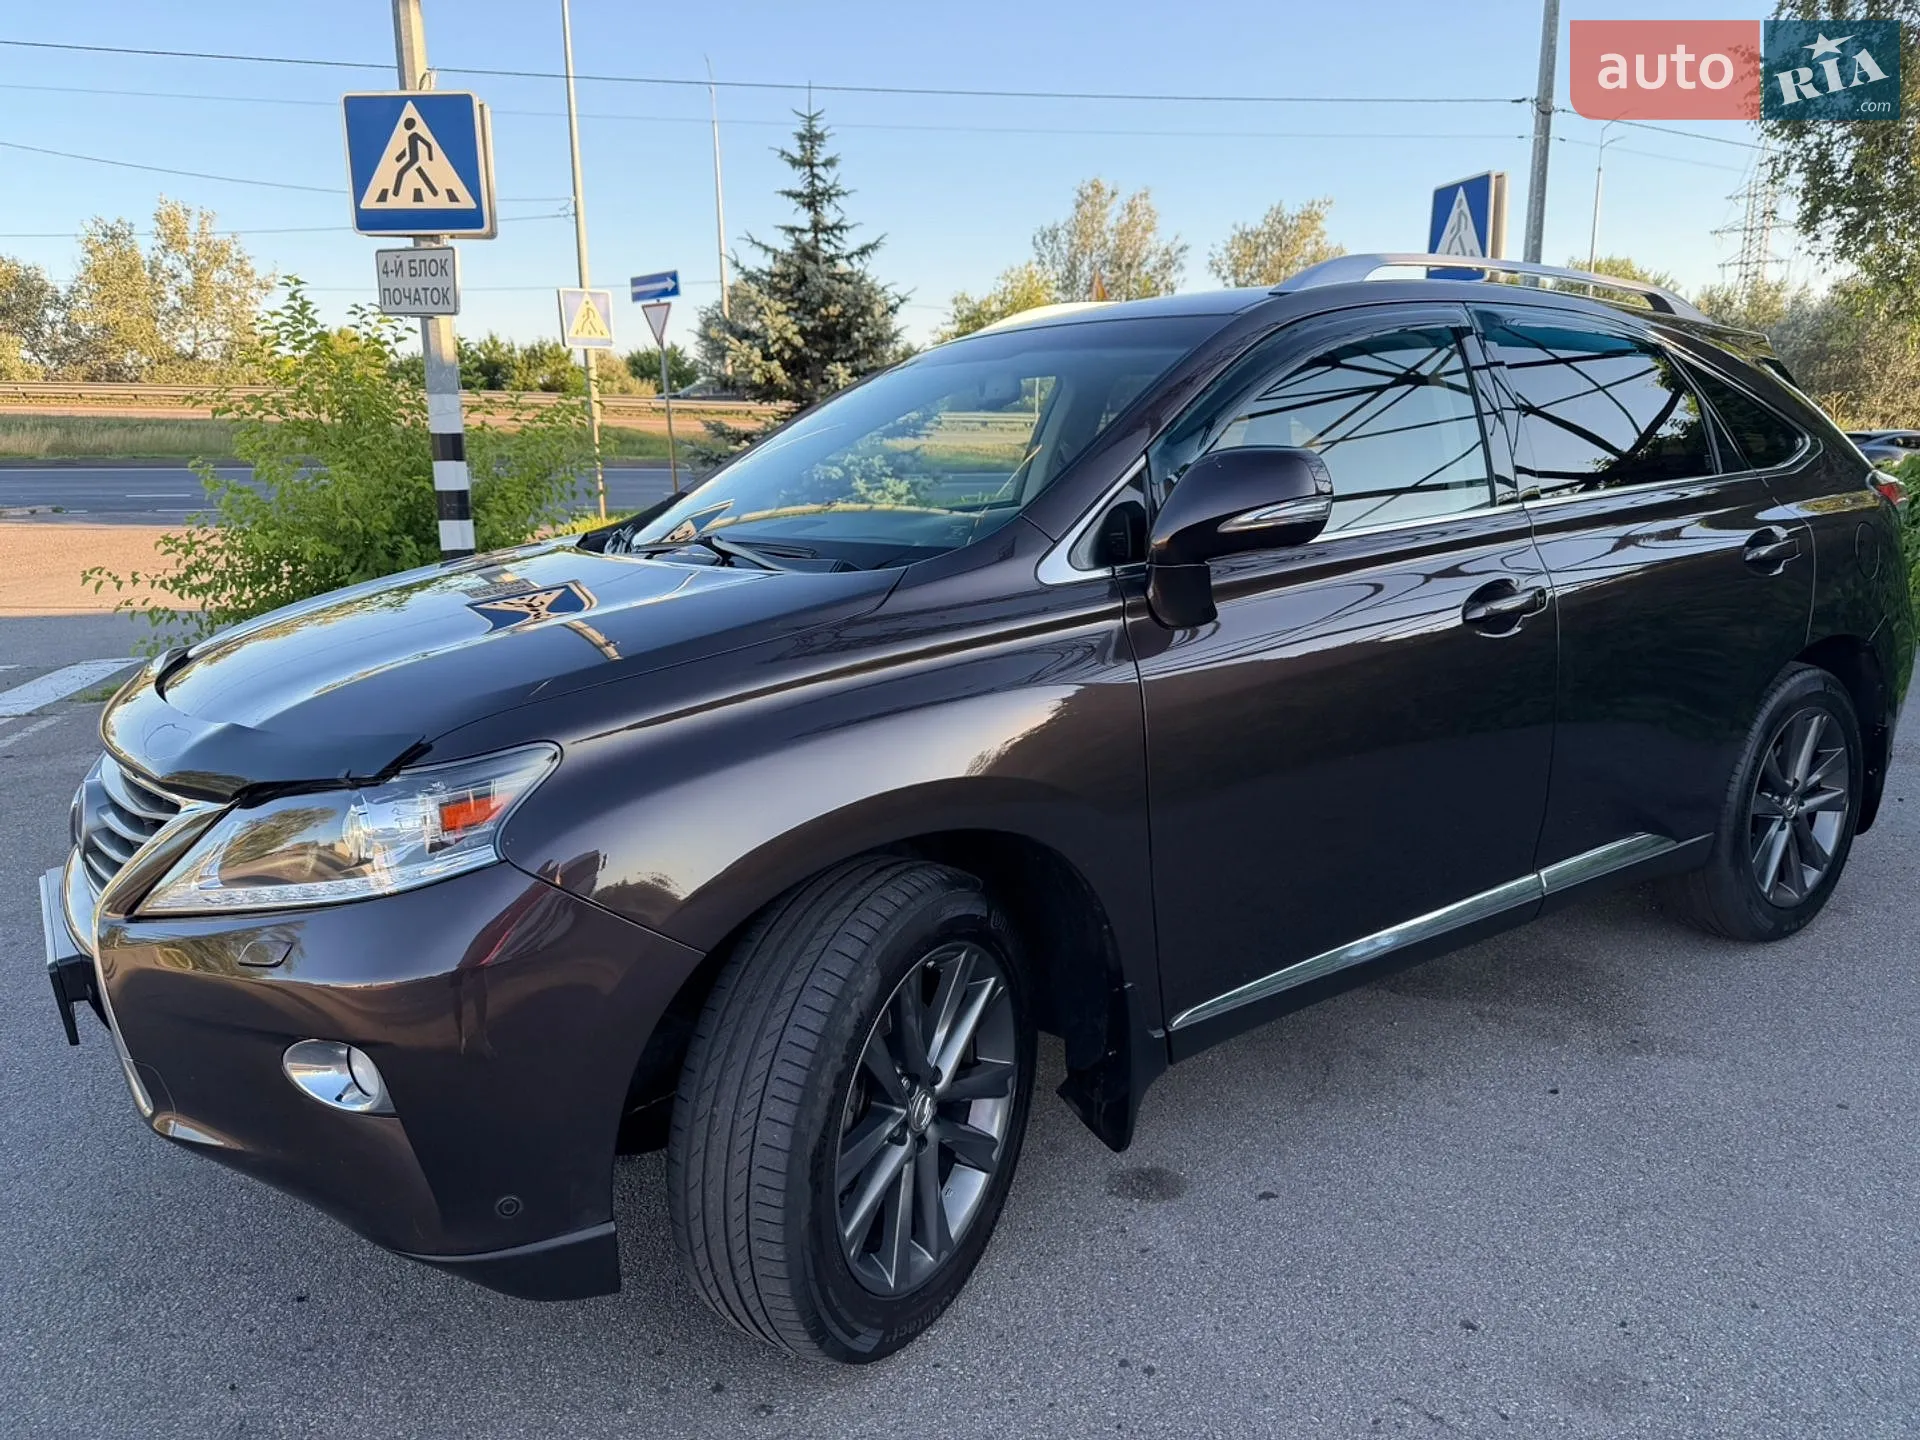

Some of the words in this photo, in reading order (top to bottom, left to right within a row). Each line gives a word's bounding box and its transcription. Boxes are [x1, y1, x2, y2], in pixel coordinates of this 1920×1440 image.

[381, 254, 404, 279] 4-Й
[407, 258, 449, 278] БЛОК
[382, 286, 451, 306] ПОЧАТОК
